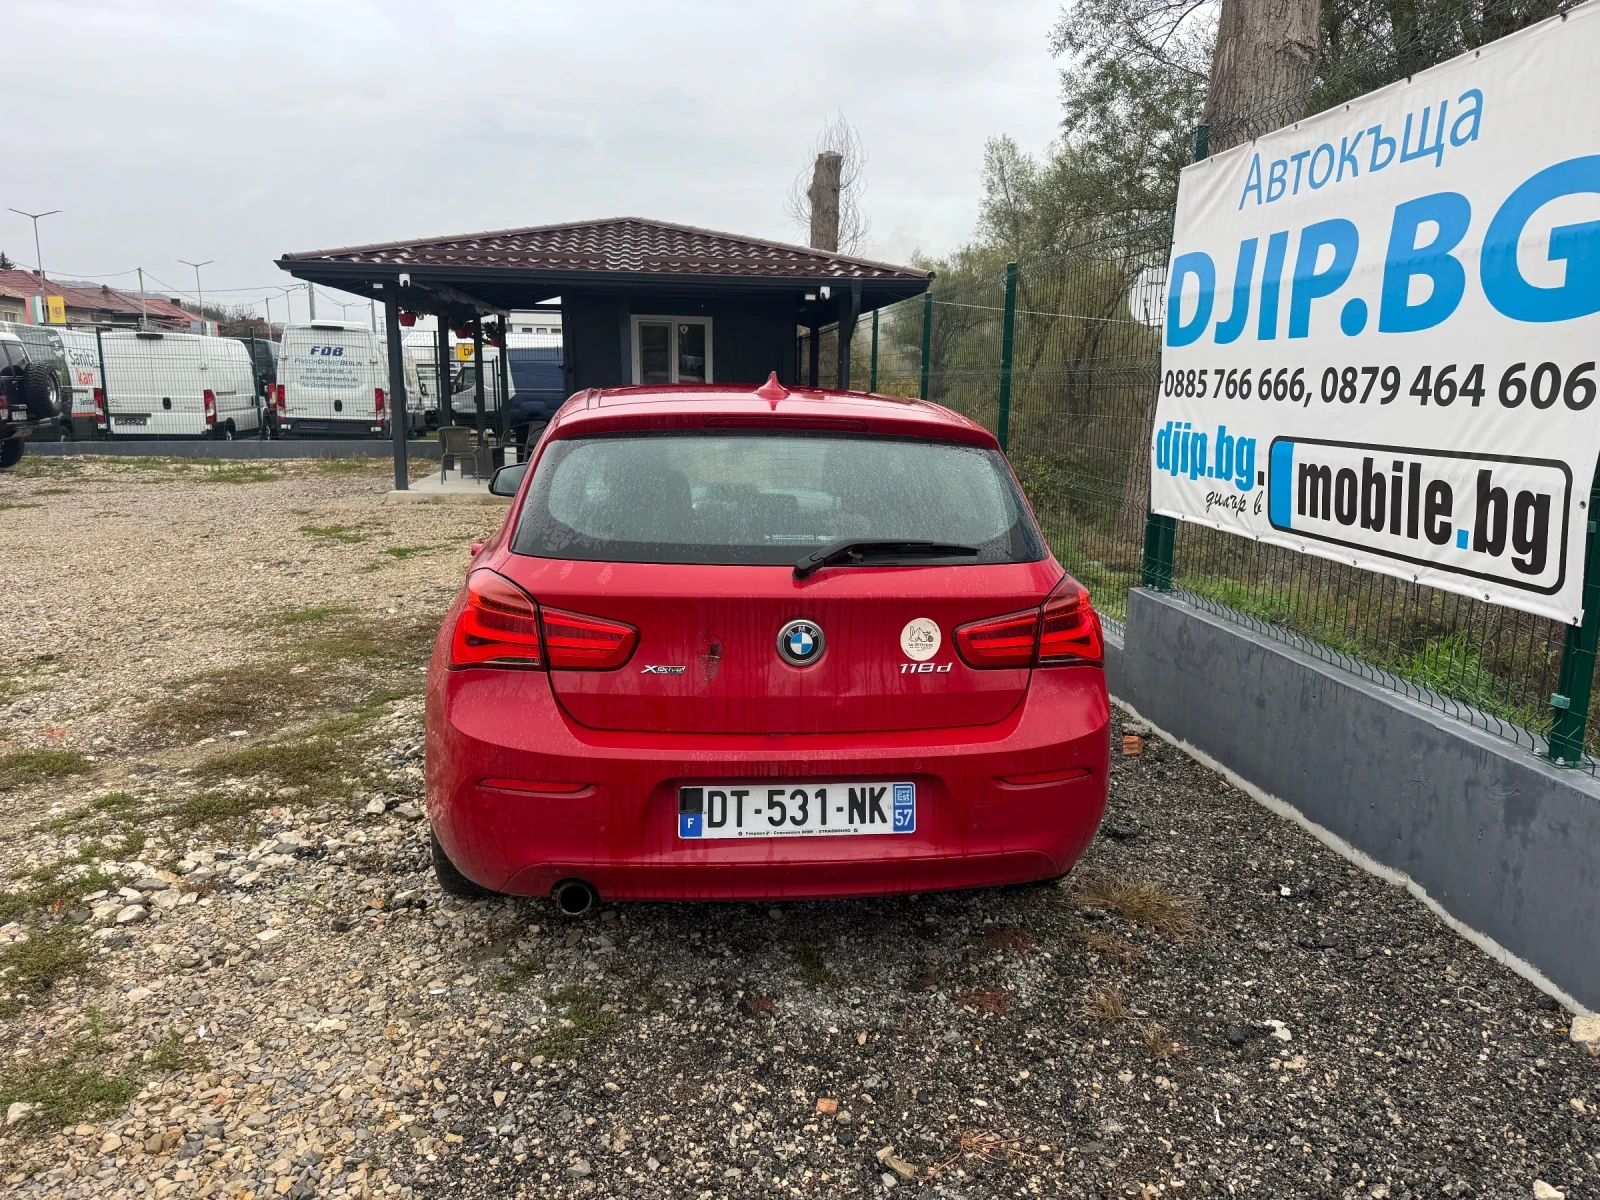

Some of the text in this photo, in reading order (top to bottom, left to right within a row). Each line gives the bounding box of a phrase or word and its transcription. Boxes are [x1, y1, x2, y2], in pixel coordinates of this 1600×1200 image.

[1240, 89, 1482, 209] Автокъща
[1166, 154, 1600, 348] DJIP.BG
[310, 346, 344, 356] FDB
[1165, 361, 1596, 411] 0885 766 666, 0879 464 606
[1298, 457, 1550, 575] mobile.bg
[787, 626, 818, 638] BMW
[688, 817, 695, 829] F
[708, 787, 887, 828] DT-531-NK
[895, 809, 913, 826] 57
